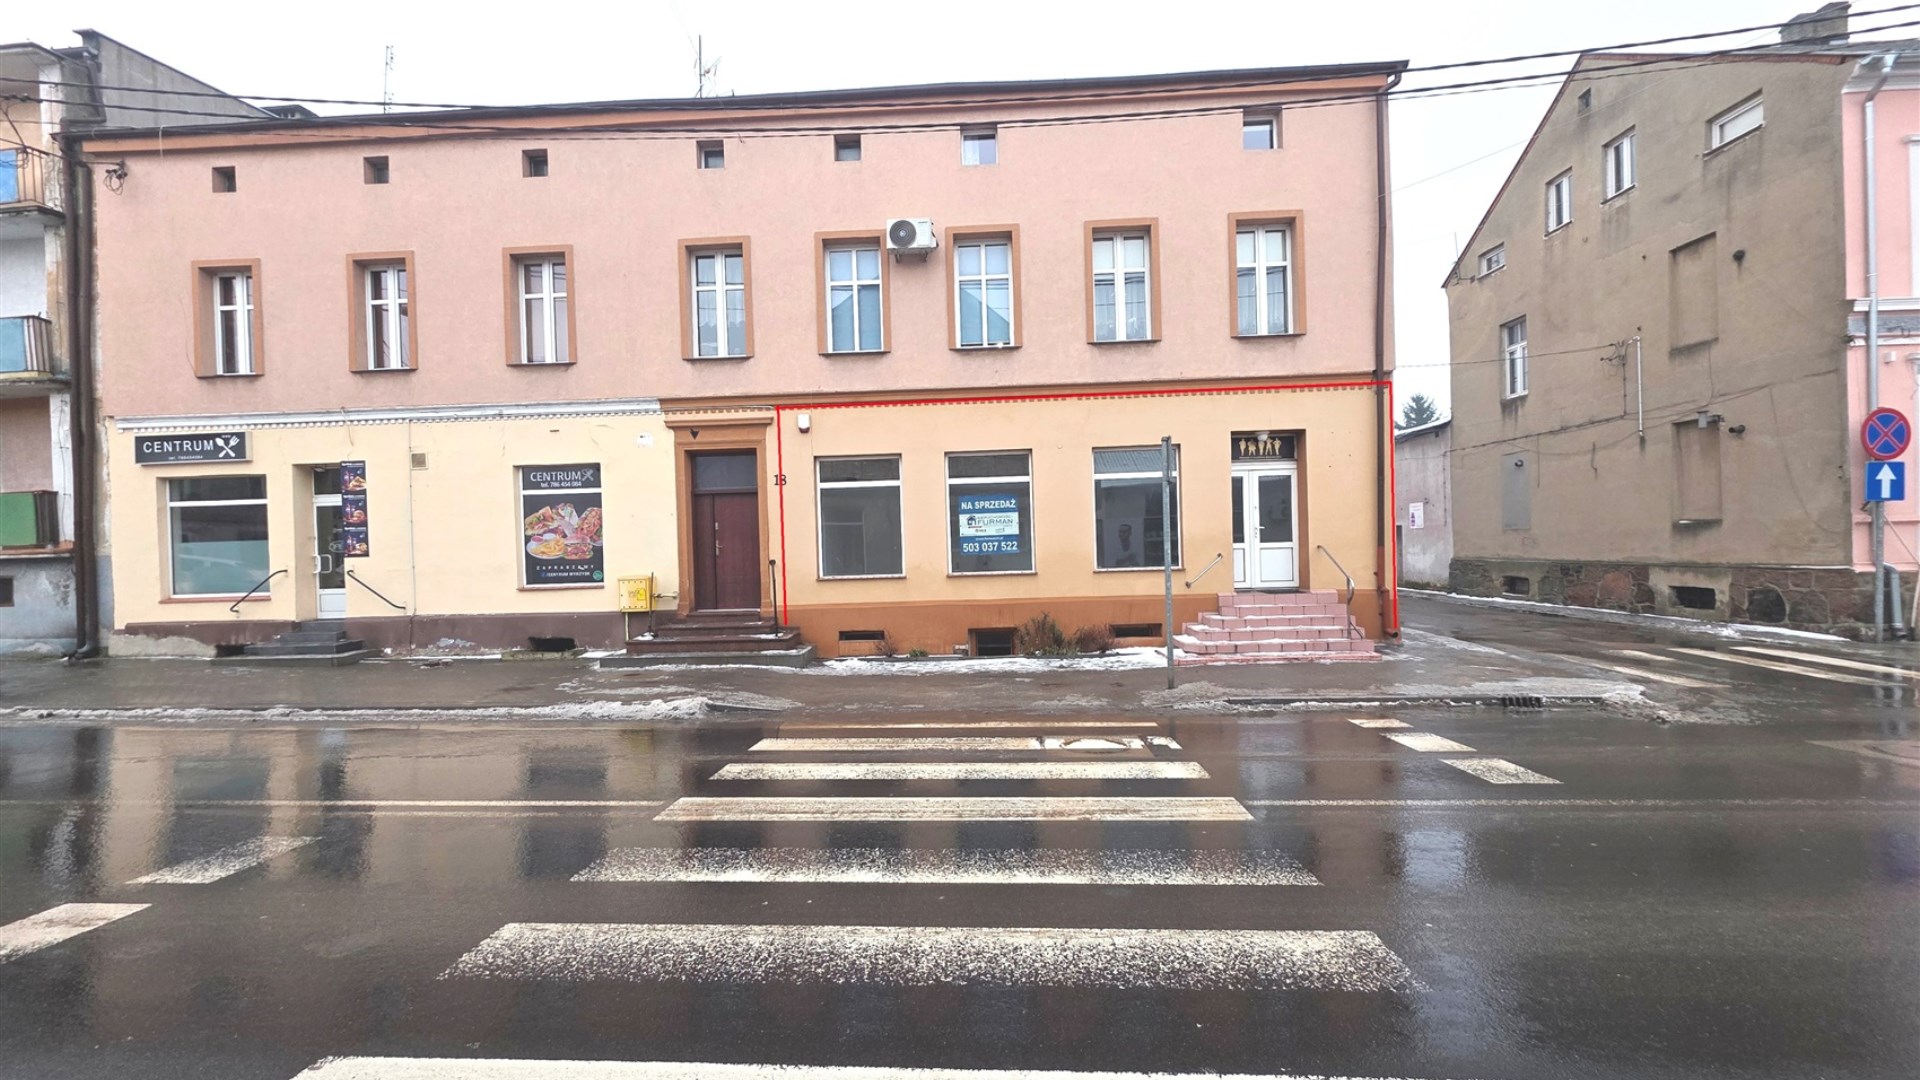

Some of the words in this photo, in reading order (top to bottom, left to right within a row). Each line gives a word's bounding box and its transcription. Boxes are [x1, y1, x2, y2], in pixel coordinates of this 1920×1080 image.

[143, 439, 214, 453] CENTRUM
[530, 471, 581, 482] CENTRUM
[961, 501, 973, 510] NA
[974, 498, 1016, 510] SPRZEDAŻ
[962, 543, 980, 553] 503
[981, 542, 999, 552] 037
[1001, 541, 1018, 551] 522
